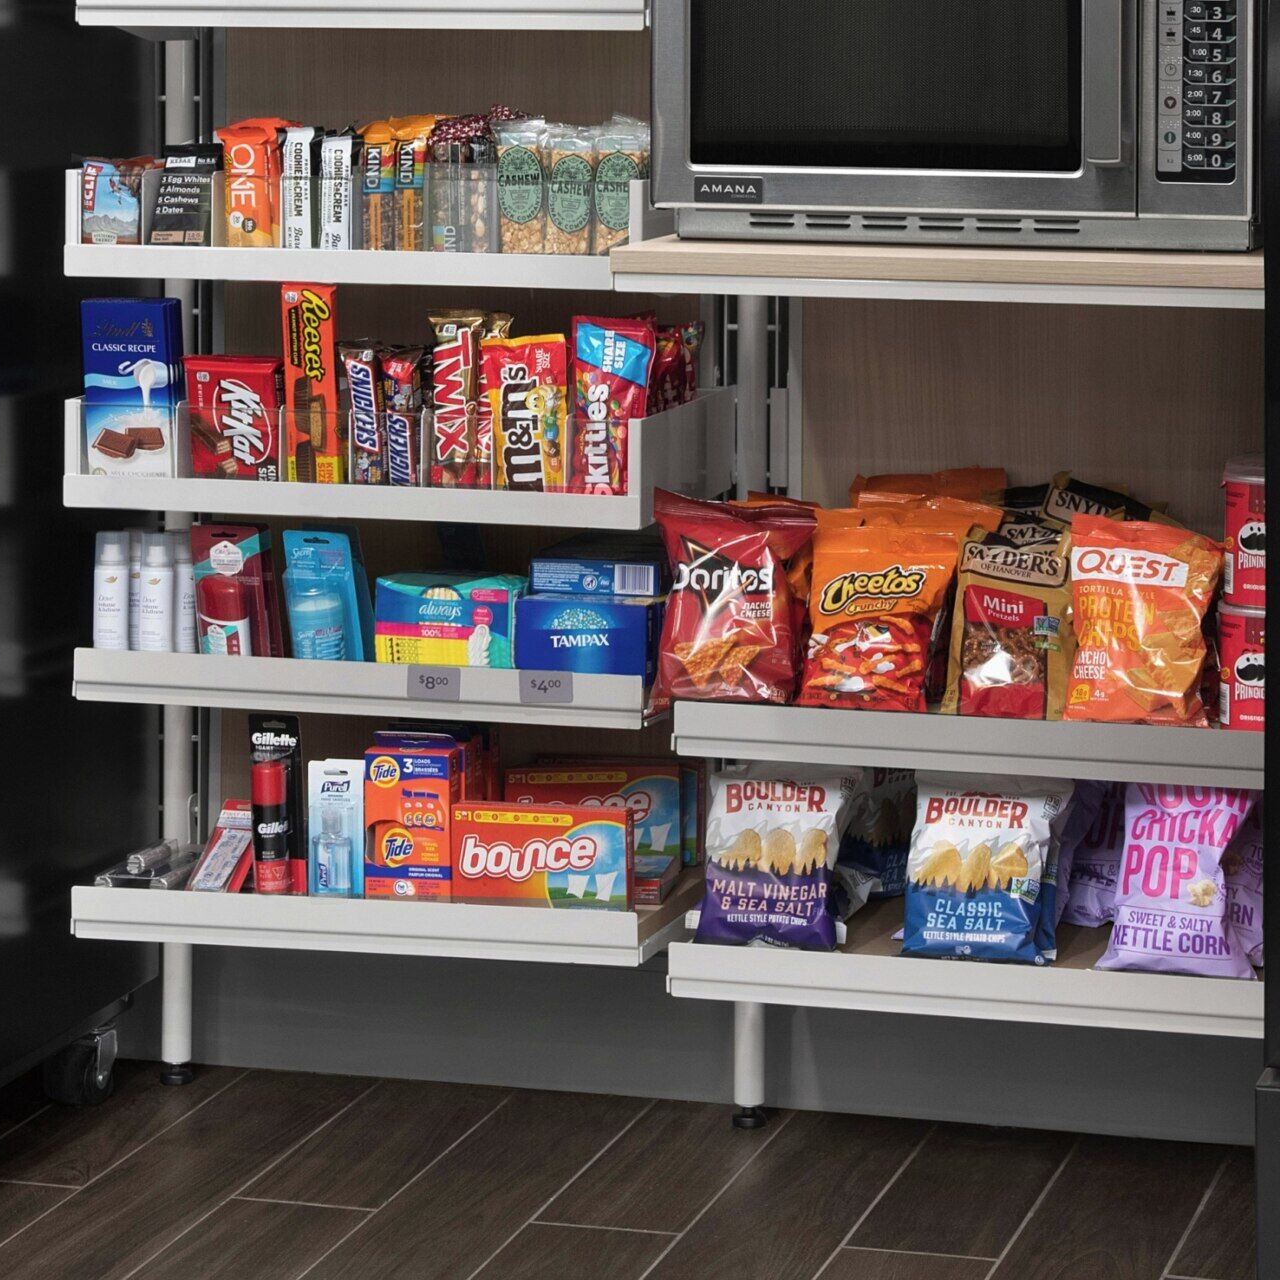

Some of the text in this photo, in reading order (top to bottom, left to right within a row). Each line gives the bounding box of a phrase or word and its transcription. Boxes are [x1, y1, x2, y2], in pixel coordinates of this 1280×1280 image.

[1212, 7, 1222, 19] 3
[1212, 28, 1222, 40] 4
[1212, 49, 1222, 61] 5
[1212, 70, 1222, 82] 6
[1212, 91, 1222, 103] 7
[1212, 112, 1222, 124] 8
[1212, 133, 1222, 145] 9
[1212, 154, 1222, 166] 0
[167, 175, 180, 184] Egg
[183, 176, 210, 184] Whites
[499, 173, 541, 186] CASHEW
[160, 185, 201, 194] 6 Almonds
[700, 184, 756, 194] AMANA
[164, 196, 198, 204] Cashews
[163, 206, 183, 214] Dates
[301, 290, 330, 381] Reese's
[92, 342, 156, 354] CLASSIC RECIPE
[350, 364, 379, 452] SNICKERS
[1076, 550, 1175, 580] QUEST
[672, 564, 774, 592] Doritos
[820, 565, 926, 614] Cheetos
[419, 600, 462, 617] always
[742, 602, 771, 610] NACHO
[740, 609, 771, 618] CHEESE
[550, 634, 609, 648] TAMPAX
[252, 731, 296, 747] Gillette
[370, 762, 400, 781] Tide
[725, 781, 826, 813] BOULDER
[747, 801, 799, 813] CANYON
[459, 835, 597, 880] bounce
[1128, 912, 1213, 931] SWEET & SALTY
[1114, 928, 1230, 955] KETTLE CORN
